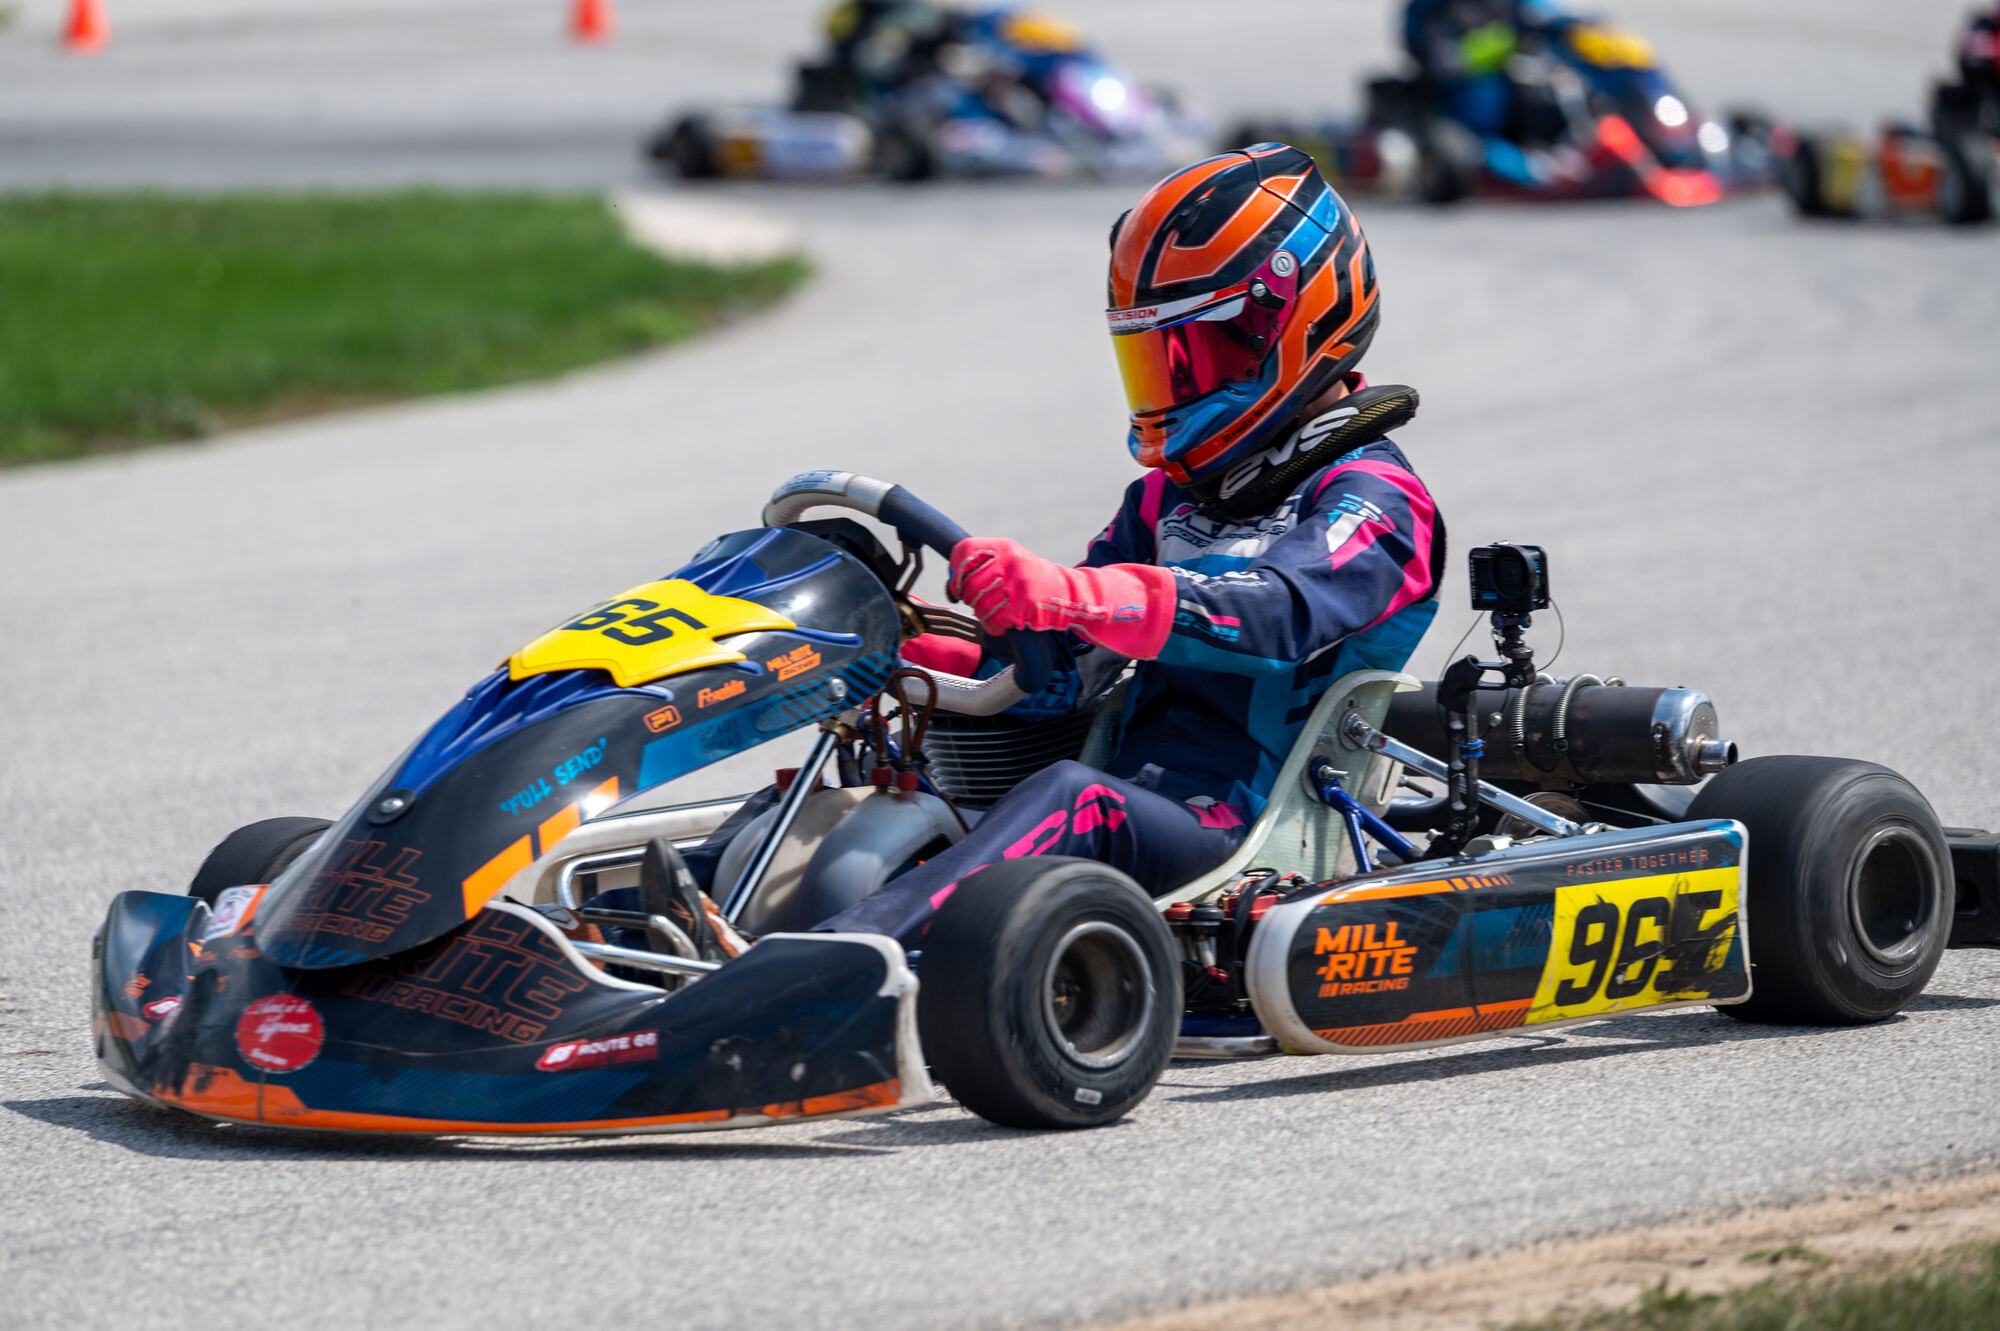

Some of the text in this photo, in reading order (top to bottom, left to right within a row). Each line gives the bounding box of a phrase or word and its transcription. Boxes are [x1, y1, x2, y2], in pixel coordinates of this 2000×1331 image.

[1105, 307, 1159, 321] ECISION
[1219, 406, 1361, 500] EVS
[316, 838, 425, 889] ILL
[1566, 848, 1711, 877] FASTER TOGETHER
[1313, 920, 1408, 955] MILL
[1338, 976, 1411, 997] RACING
[577, 1036, 632, 1056] ROUTE
[632, 1031, 658, 1048] 66
